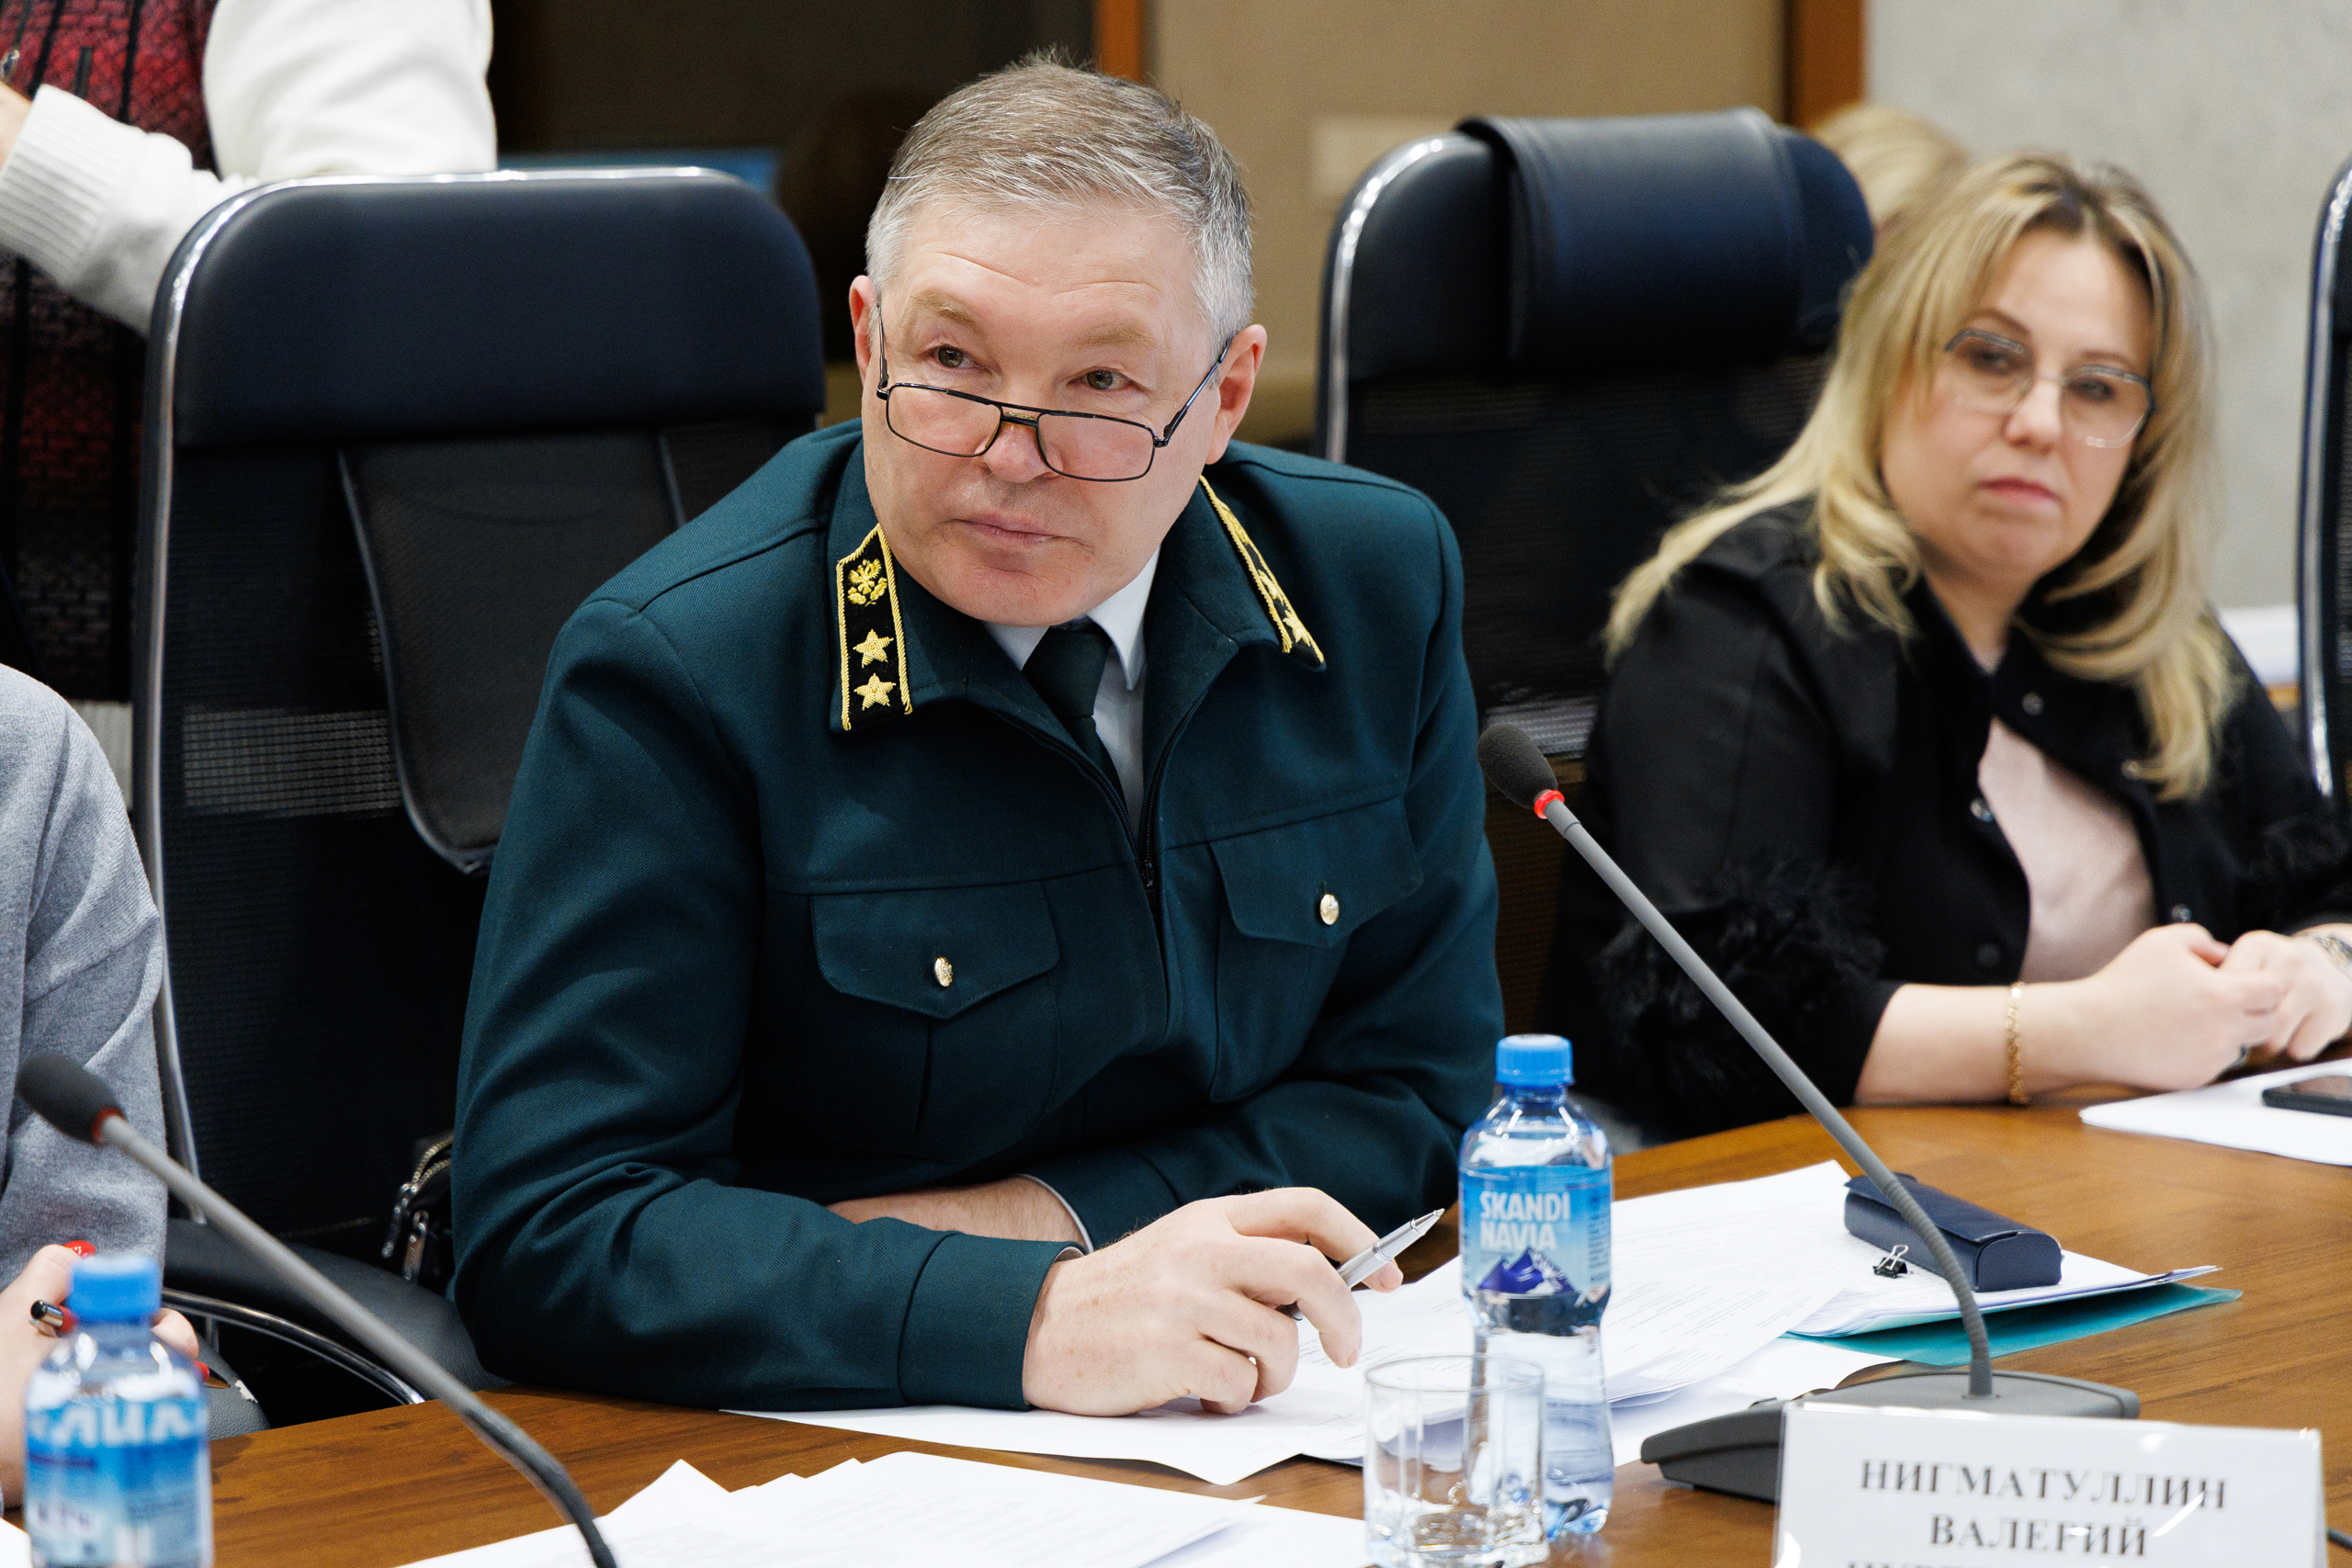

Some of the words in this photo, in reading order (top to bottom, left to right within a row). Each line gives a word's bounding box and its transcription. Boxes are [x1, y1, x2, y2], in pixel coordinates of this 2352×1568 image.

[1479, 1190, 1571, 1223] SKANDI
[1480, 1220, 1557, 1250] NAVIA
[1859, 1459, 2227, 1509] НИГМАТУЛЛИН
[1930, 1514, 2147, 1556] ВАЛЕРИЙ
